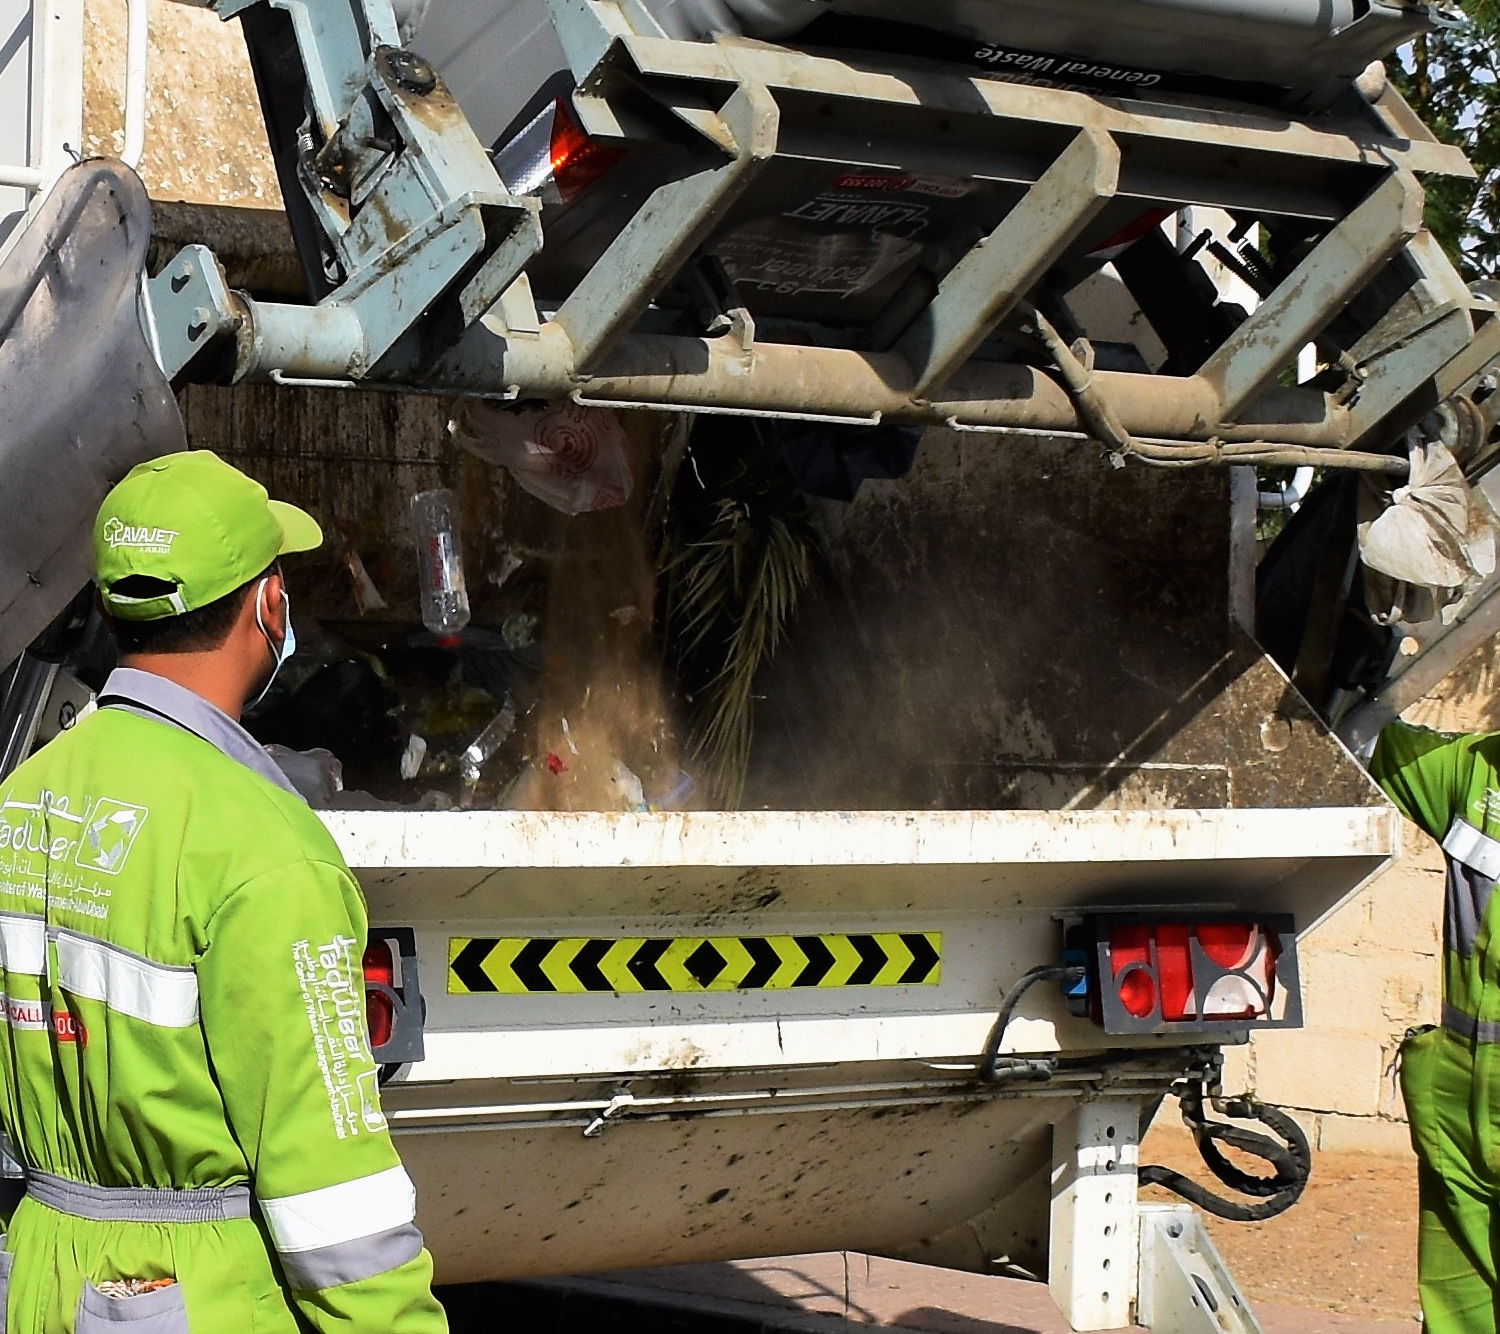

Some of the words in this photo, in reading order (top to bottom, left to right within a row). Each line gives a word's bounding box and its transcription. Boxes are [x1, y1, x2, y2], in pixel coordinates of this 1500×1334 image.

[974, 46, 1056, 72] Waste
[1054, 60, 1163, 88] General
[781, 201, 913, 227] LAVAJET
[114, 526, 181, 545] LAVAJET
[317, 939, 367, 1064] Tadweer
